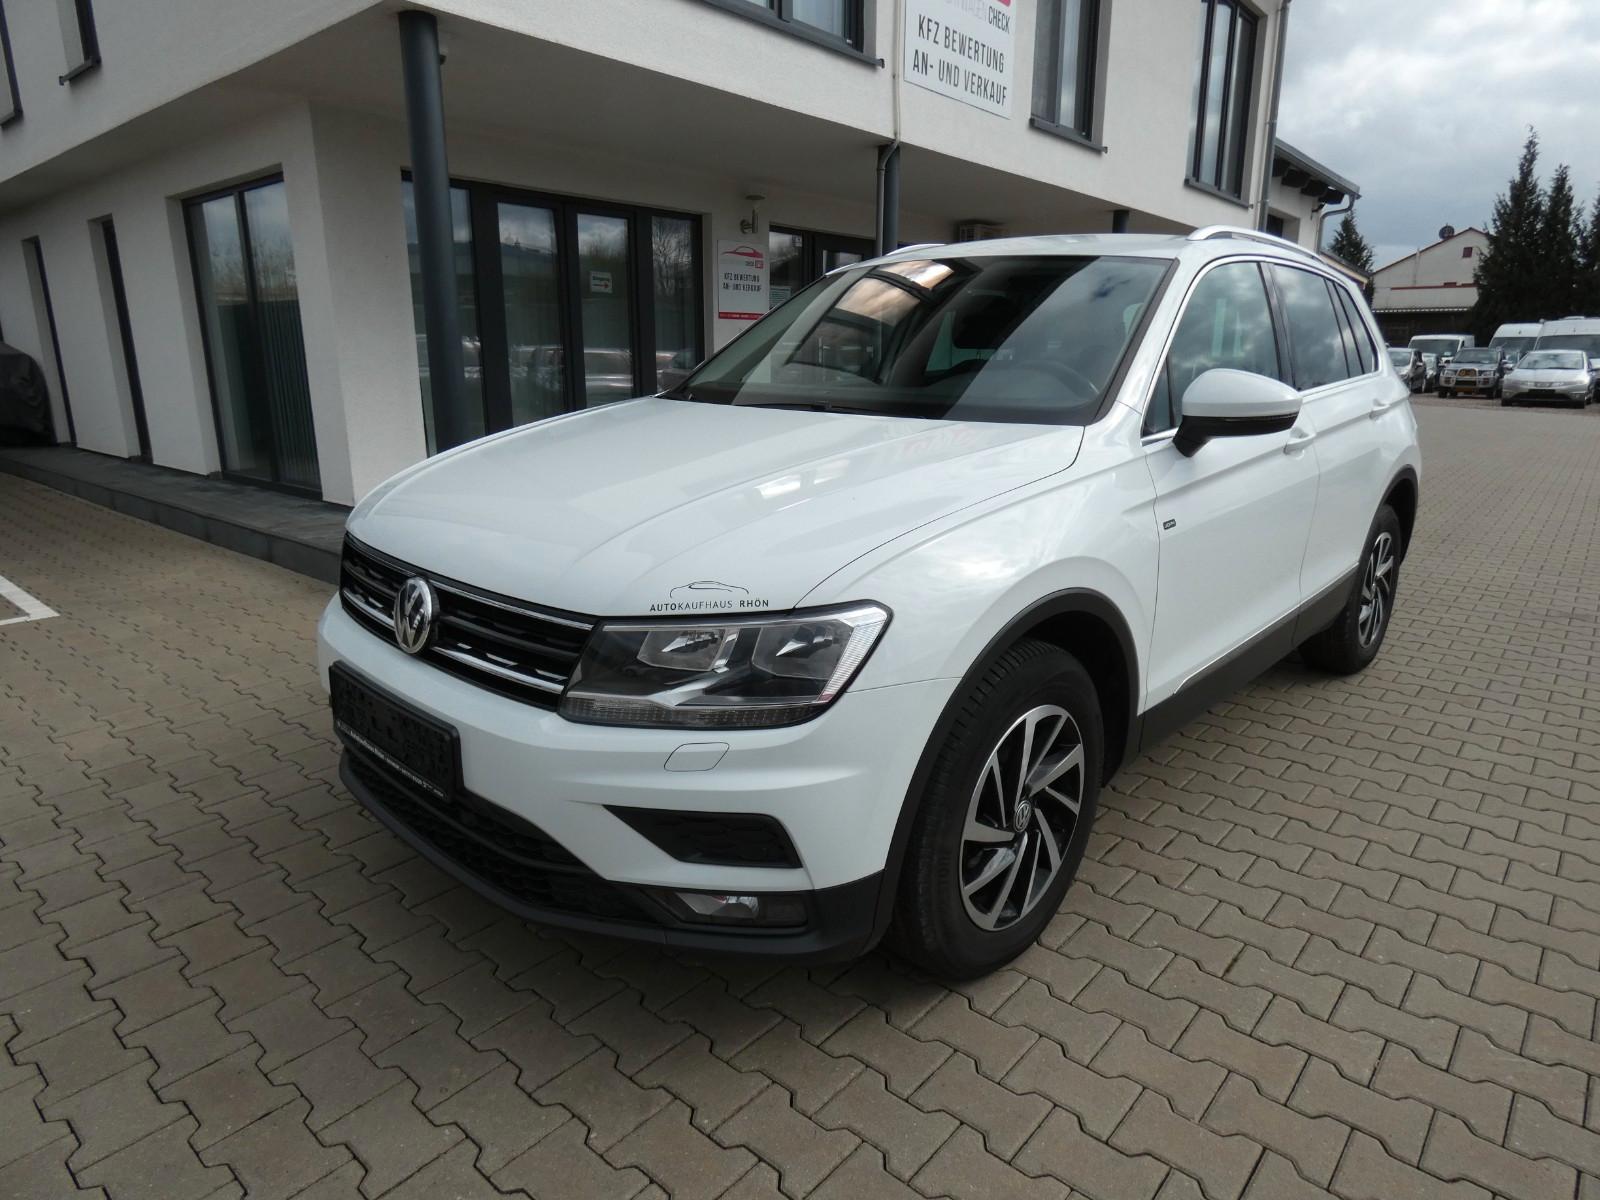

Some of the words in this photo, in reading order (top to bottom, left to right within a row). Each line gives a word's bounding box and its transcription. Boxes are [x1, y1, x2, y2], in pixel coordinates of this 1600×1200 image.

[988, 6, 1011, 34] CHECK
[918, 14, 940, 45] KFZ
[944, 26, 1005, 73] BEWERTUNG
[912, 49, 934, 76] AN-
[938, 58, 960, 88] UND
[964, 69, 1007, 107] VERKAUF
[649, 600, 733, 612] AUTOKAUFHAUS
[739, 598, 769, 608] RHÖN
